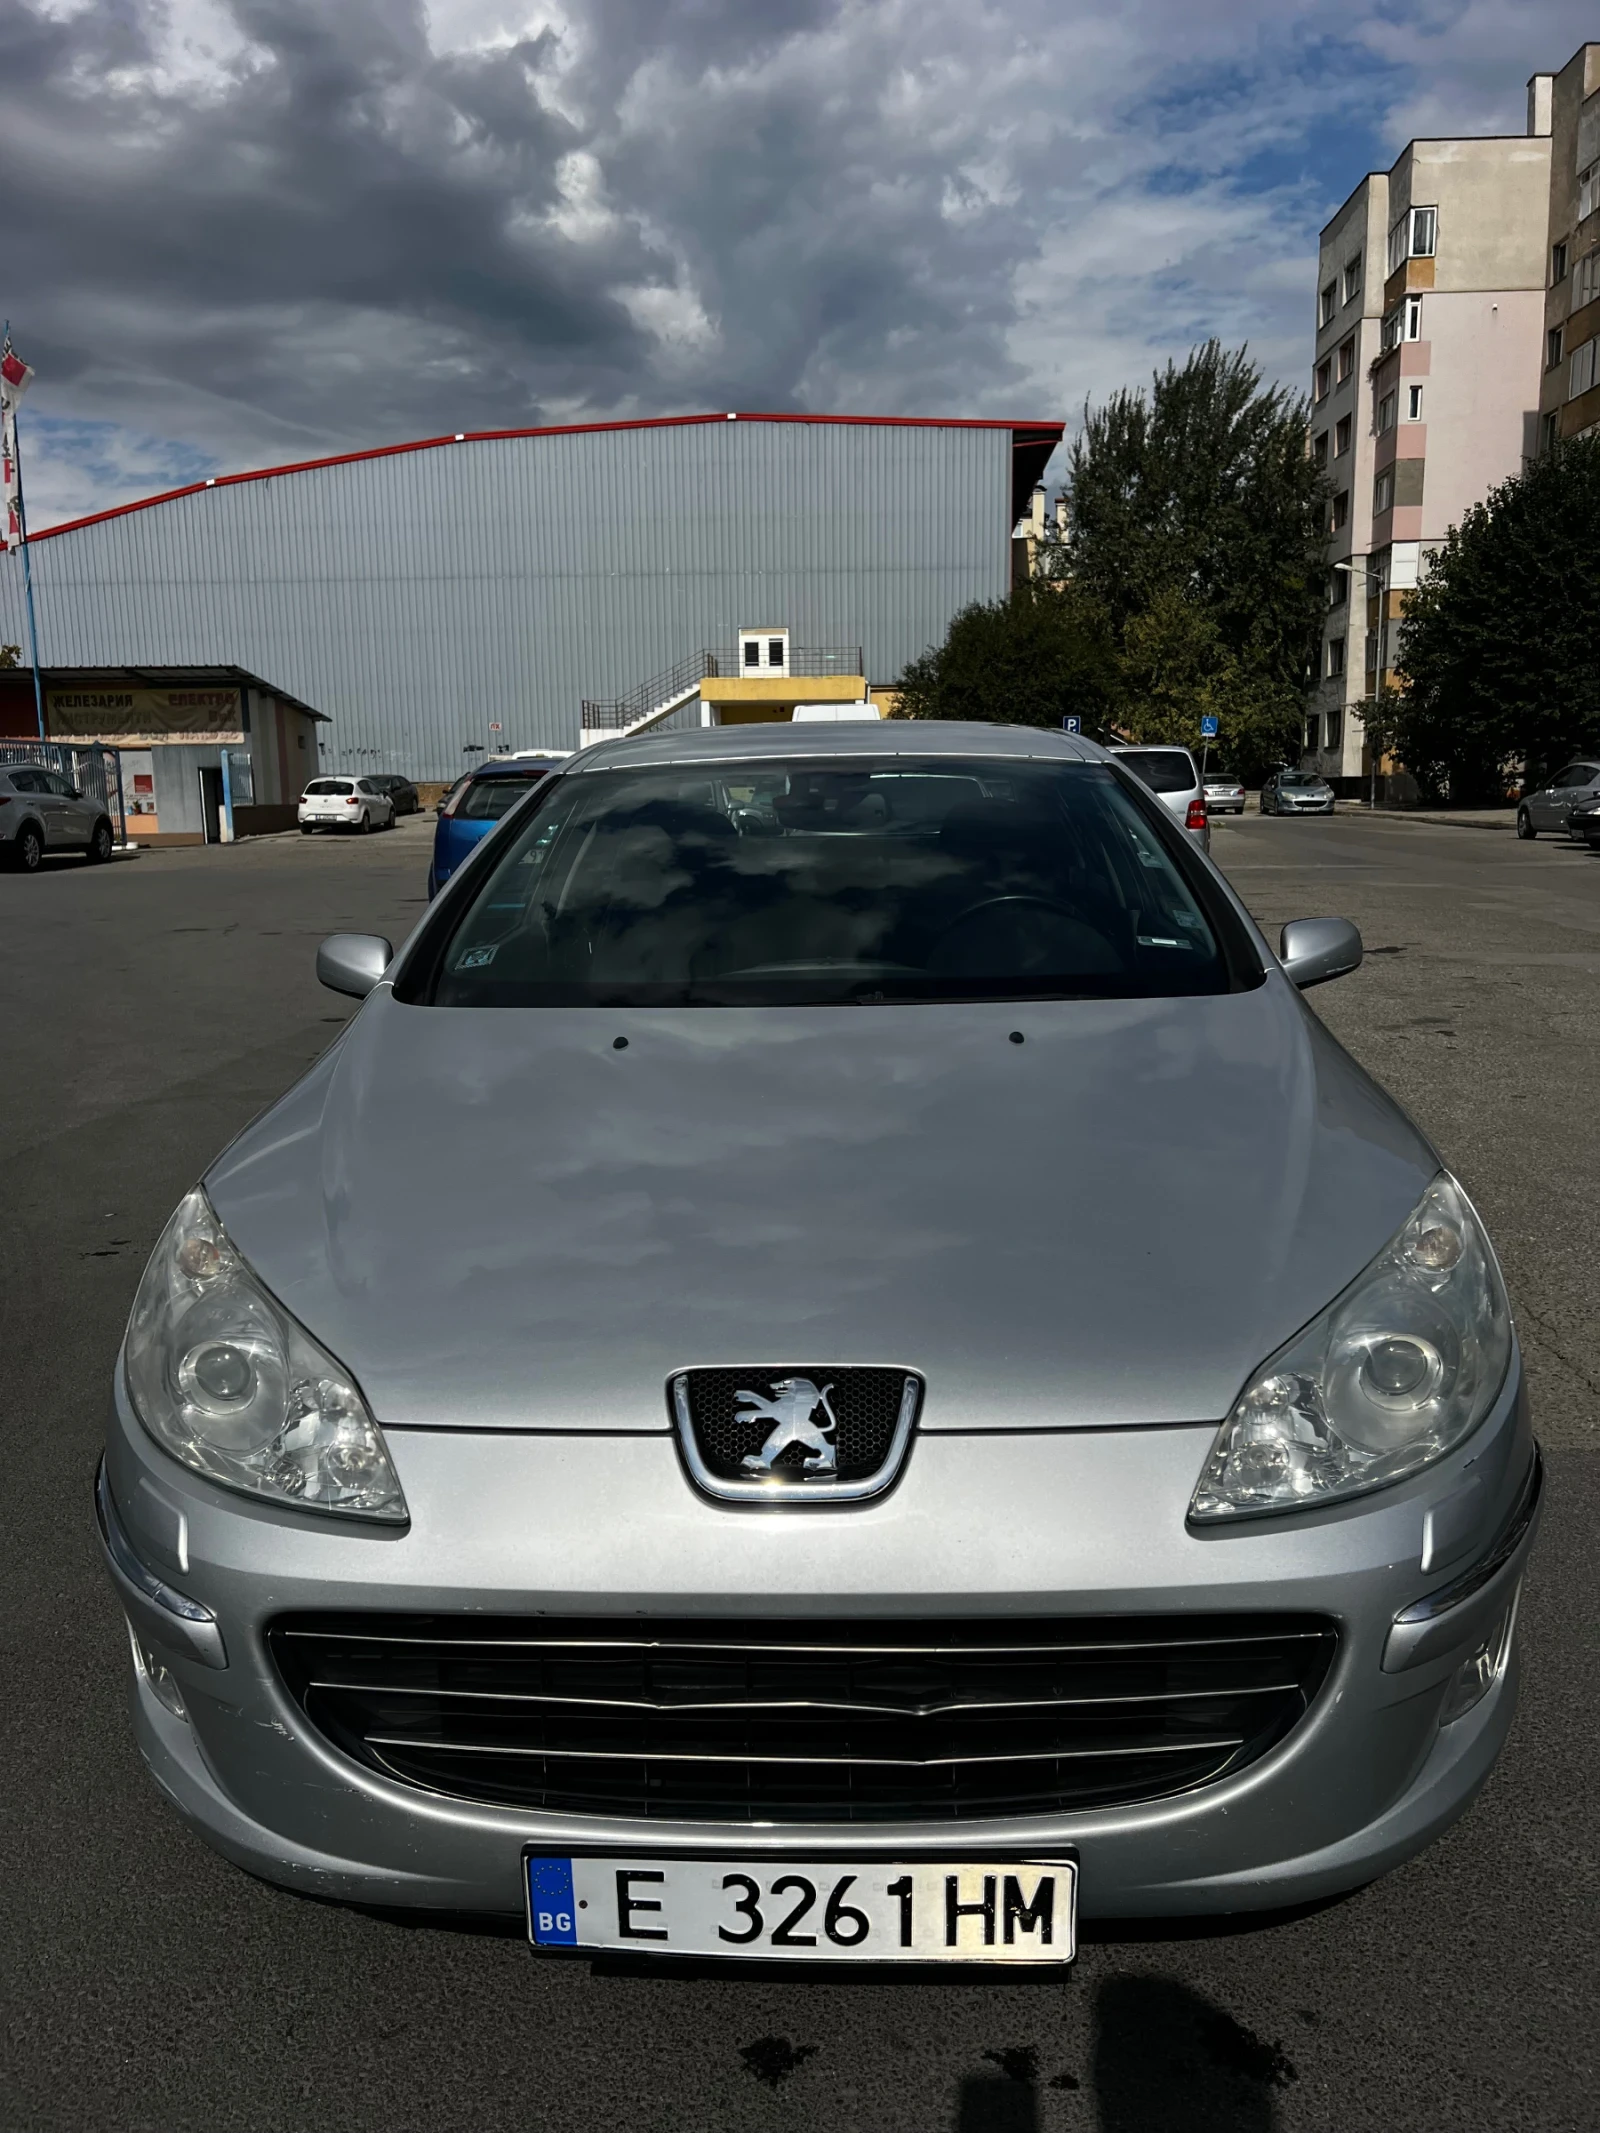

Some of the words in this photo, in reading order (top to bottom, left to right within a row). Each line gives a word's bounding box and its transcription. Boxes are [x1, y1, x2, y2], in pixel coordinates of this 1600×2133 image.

[53, 694, 133, 708] ЖЕЛЕЗАРИЯ
[615, 1869, 669, 1941] E
[718, 1873, 914, 1948] 3261
[944, 1875, 1058, 1947] HM
[538, 1912, 572, 1932] BG
